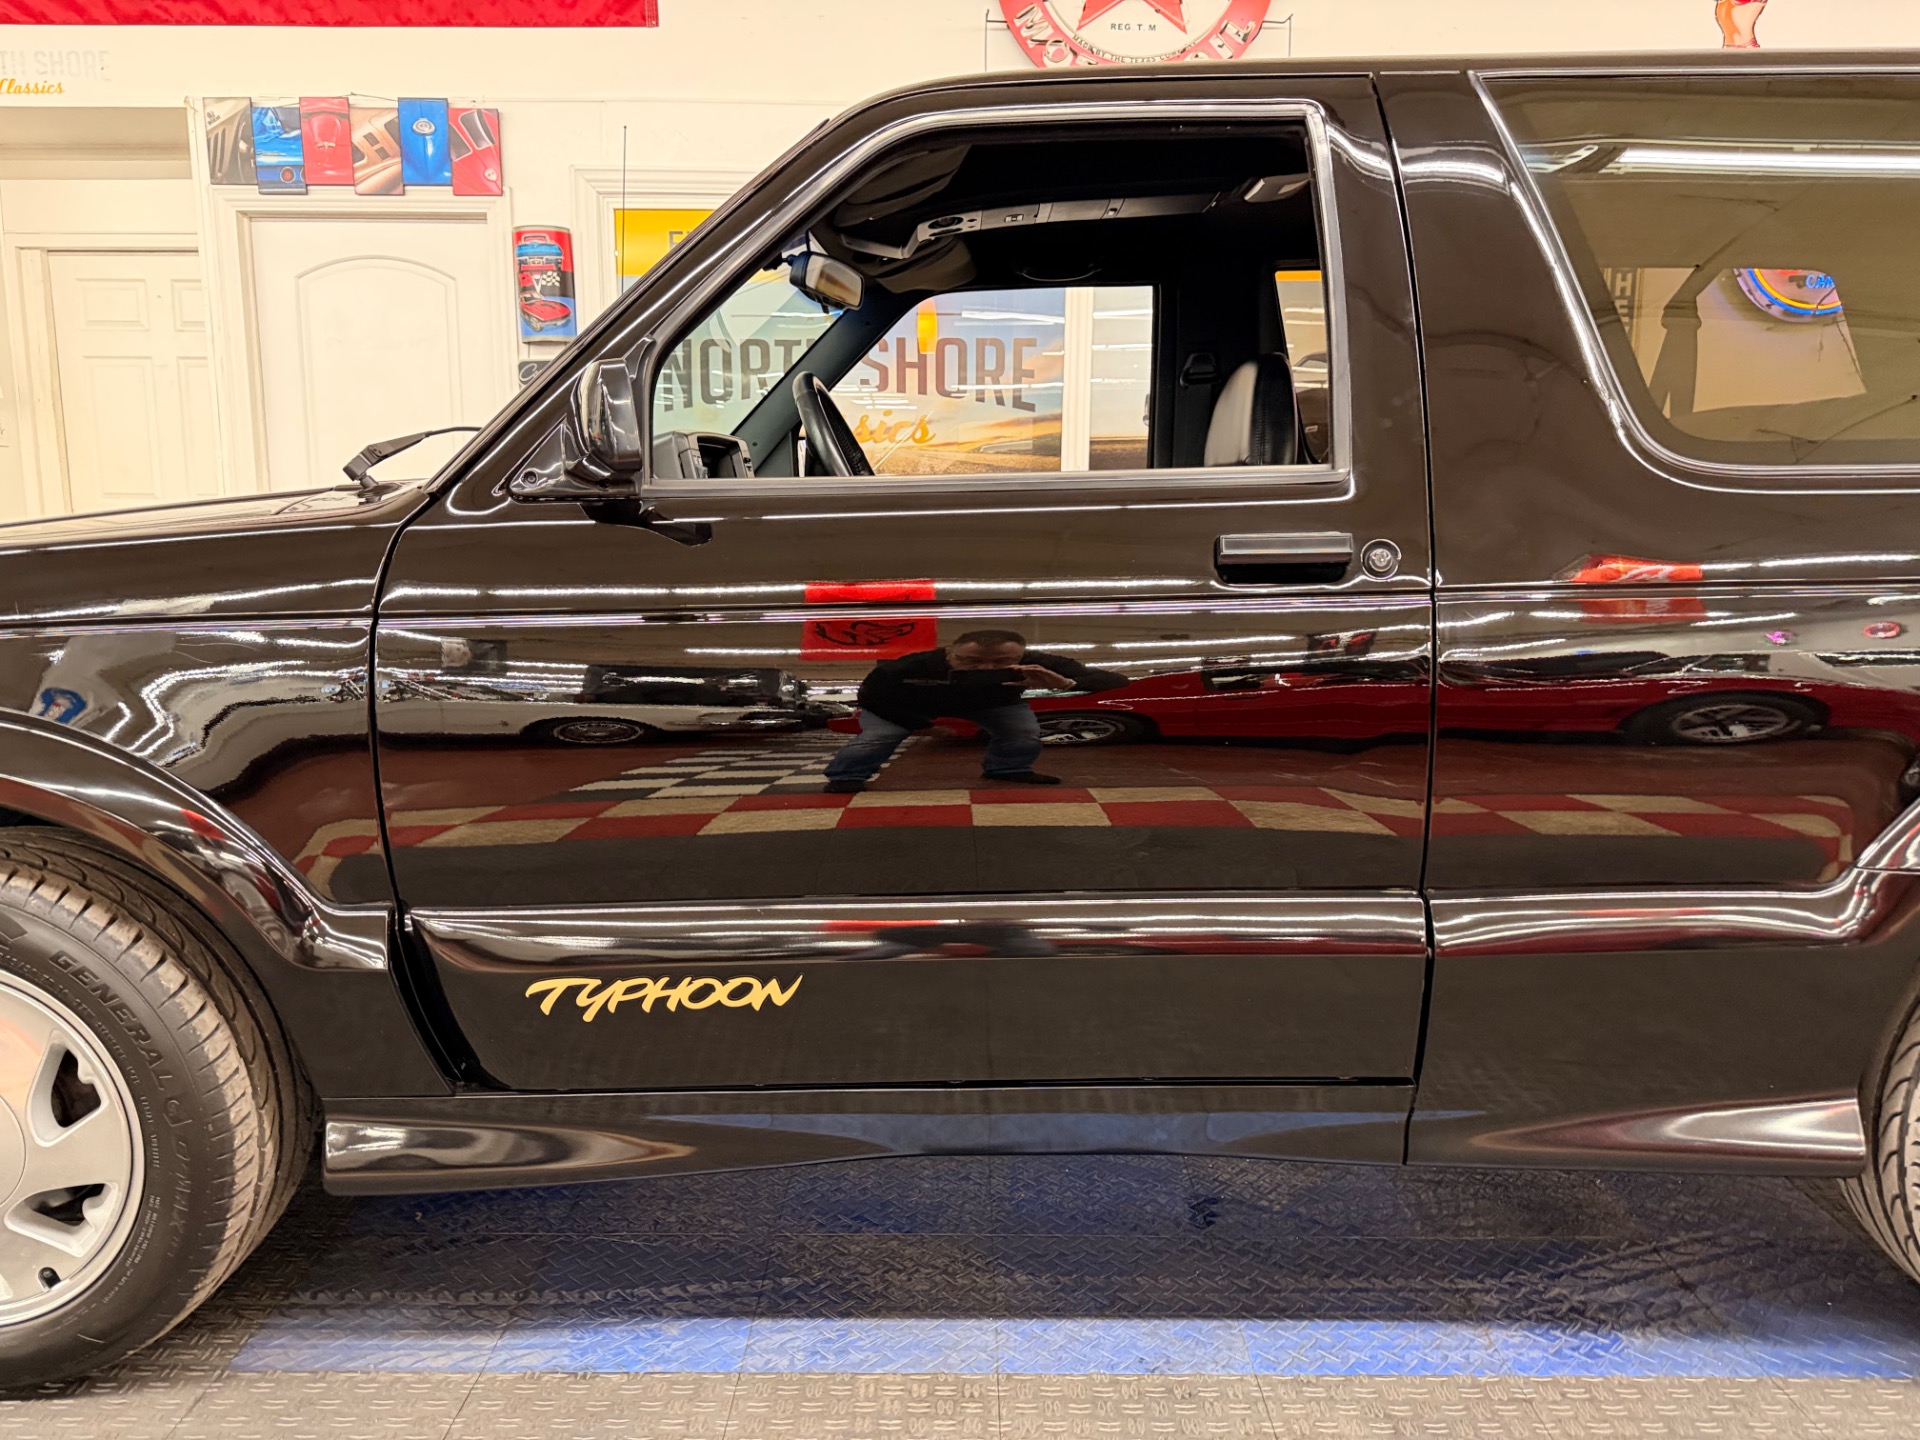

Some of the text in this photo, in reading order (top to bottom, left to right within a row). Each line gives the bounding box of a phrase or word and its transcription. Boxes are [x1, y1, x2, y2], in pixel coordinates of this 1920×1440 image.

[1110, 23, 1131, 31] REG
[33, 50, 111, 82] SHORE
[1096, 49, 1106, 58] BY
[1110, 55, 1126, 63] THE
[662, 337, 1037, 412] NORT SHORE
[525, 975, 804, 1023] TYPHOON
[49, 950, 173, 1092] GENERAL
